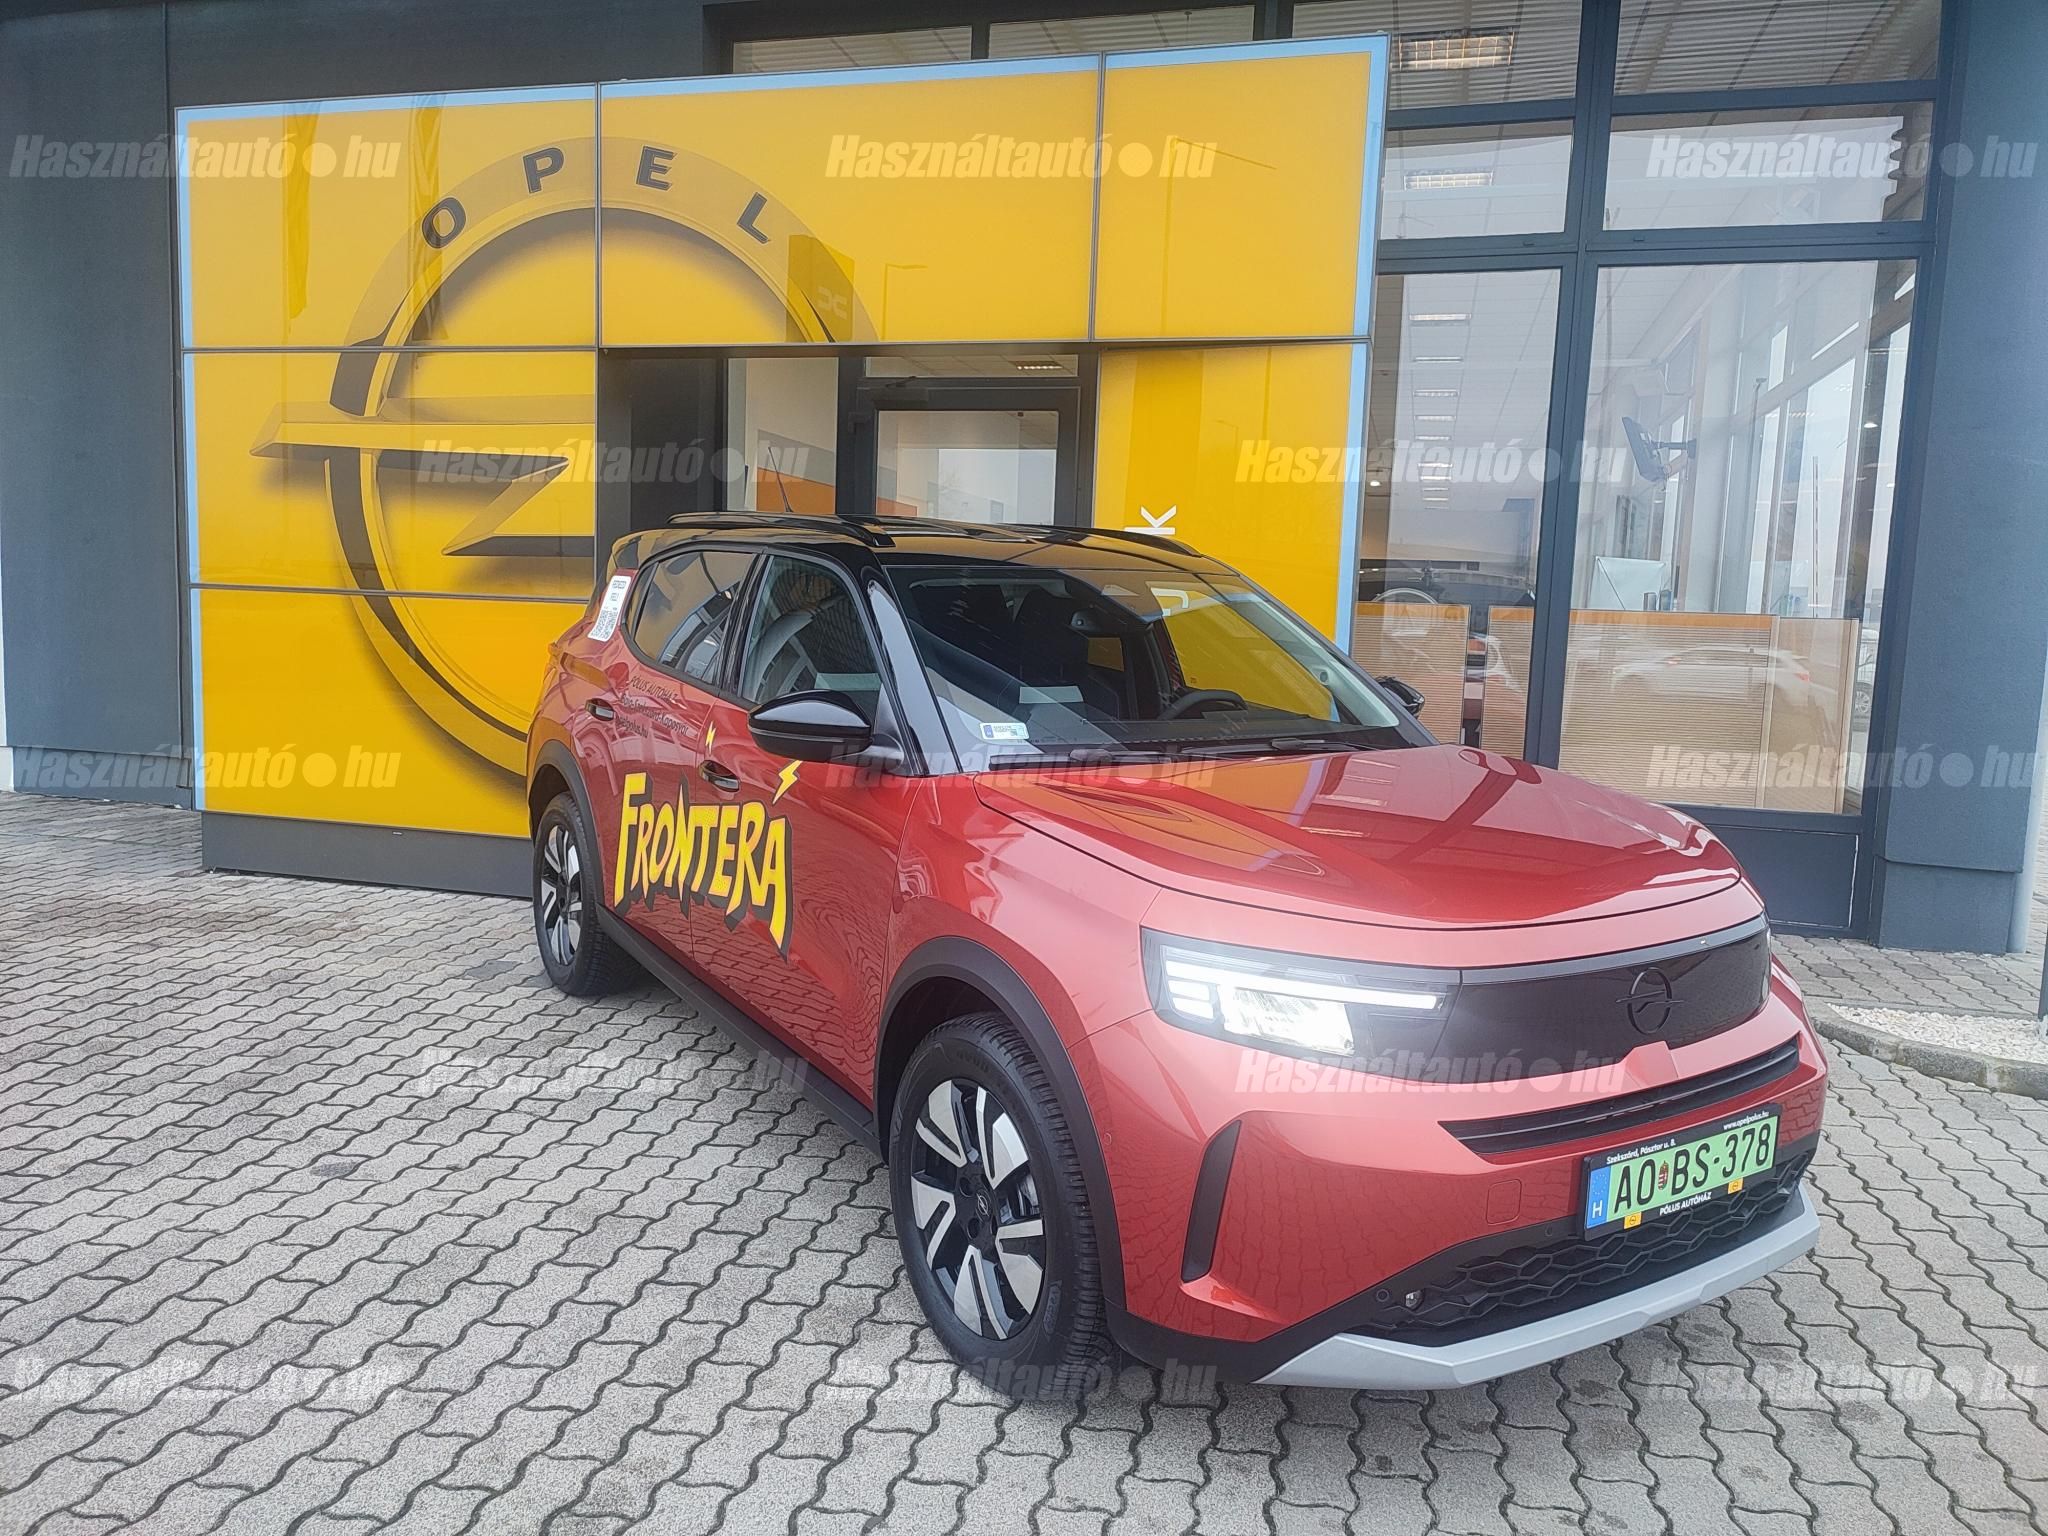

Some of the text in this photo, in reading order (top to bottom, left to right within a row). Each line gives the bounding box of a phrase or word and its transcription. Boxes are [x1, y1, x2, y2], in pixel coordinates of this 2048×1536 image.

[421, 146, 771, 249] OPEL
[613, 771, 792, 962] FRONTERA
[1606, 1148, 1640, 1165] Szekszárd,
[1671, 1123, 1772, 1196] BS-378
[1592, 1200, 1603, 1219] H
[1659, 1191, 1712, 1216] PÓLUS AUTÓHÁZ
